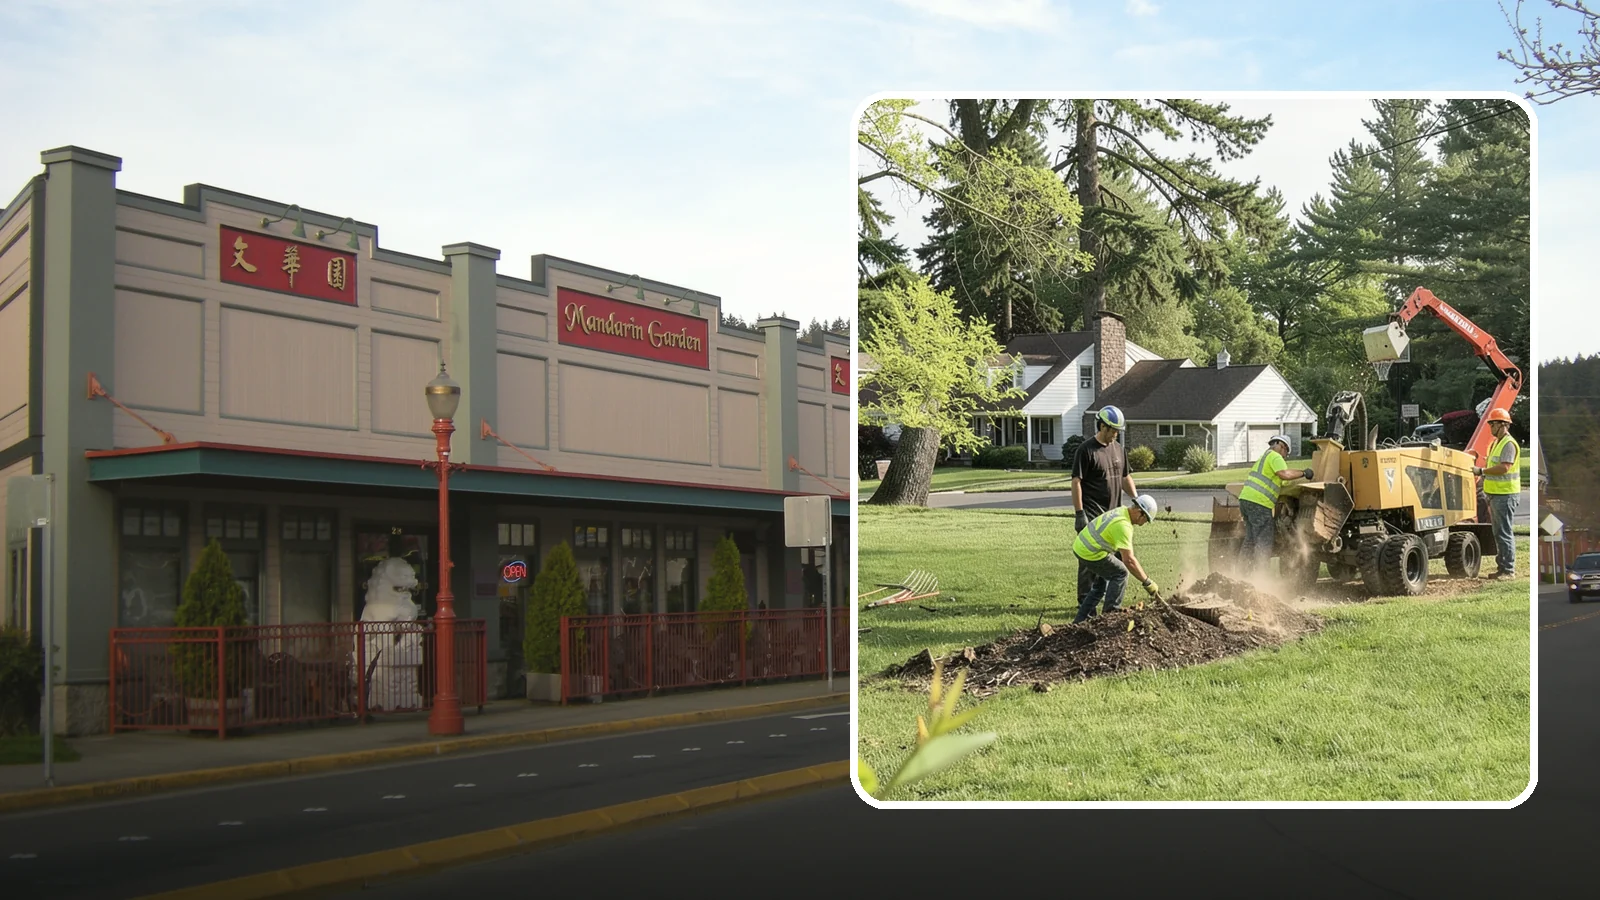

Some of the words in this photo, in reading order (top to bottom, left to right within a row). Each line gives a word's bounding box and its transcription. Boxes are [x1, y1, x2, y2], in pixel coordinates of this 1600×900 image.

[230, 235, 346, 291] 文華園
[564, 302, 644, 341] Mandarin
[648, 320, 702, 352] Garden
[503, 565, 527, 578] OPEN
